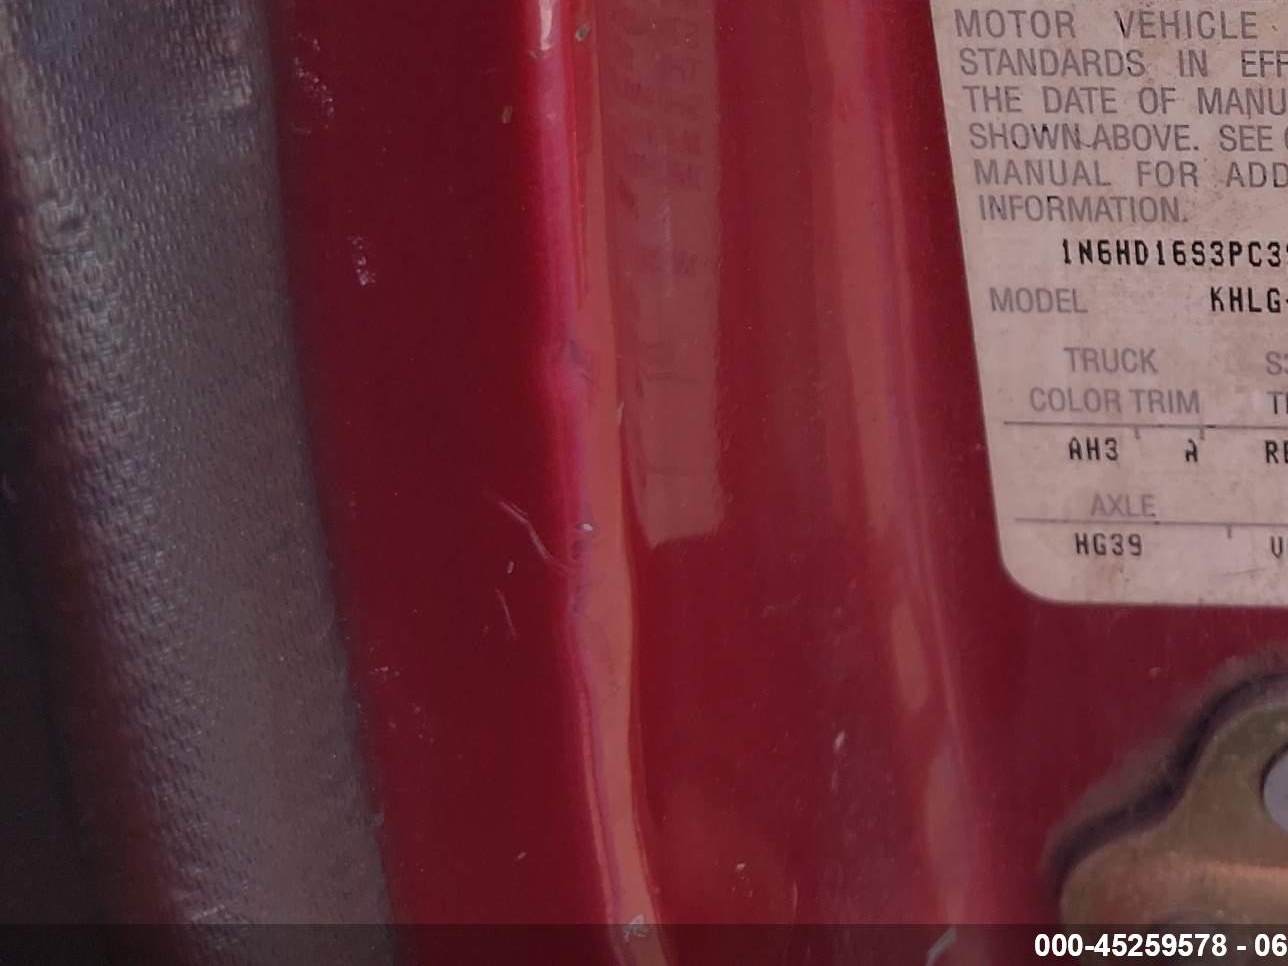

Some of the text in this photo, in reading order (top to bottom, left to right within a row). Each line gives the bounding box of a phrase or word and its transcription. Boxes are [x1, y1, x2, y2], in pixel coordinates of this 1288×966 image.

[954, 8, 1076, 39] MOTOR
[1114, 8, 1258, 40] VEHICLE
[959, 49, 1146, 78] STANDARDS
[1178, 48, 1209, 78] IN
[962, 86, 1024, 113] THE
[1042, 86, 1118, 114] DATE
[1138, 86, 1177, 114] OF
[969, 124, 1084, 152] SHOWN
[1085, 124, 1199, 152] ABOVE.
[1219, 125, 1274, 153] SEE
[974, 162, 1111, 188] MANUAL
[1136, 162, 1199, 188] FOR
[979, 194, 1188, 224] INFORMATION.
[989, 287, 1088, 313] MODEL
[1064, 347, 1158, 374] TRUCK
[1029, 389, 1121, 414] COLOR
[1134, 388, 1199, 414] TRIM
[1068, 437, 1119, 463] AH3
[1090, 494, 1155, 518] AXLE
[1074, 533, 1143, 557] HG39
